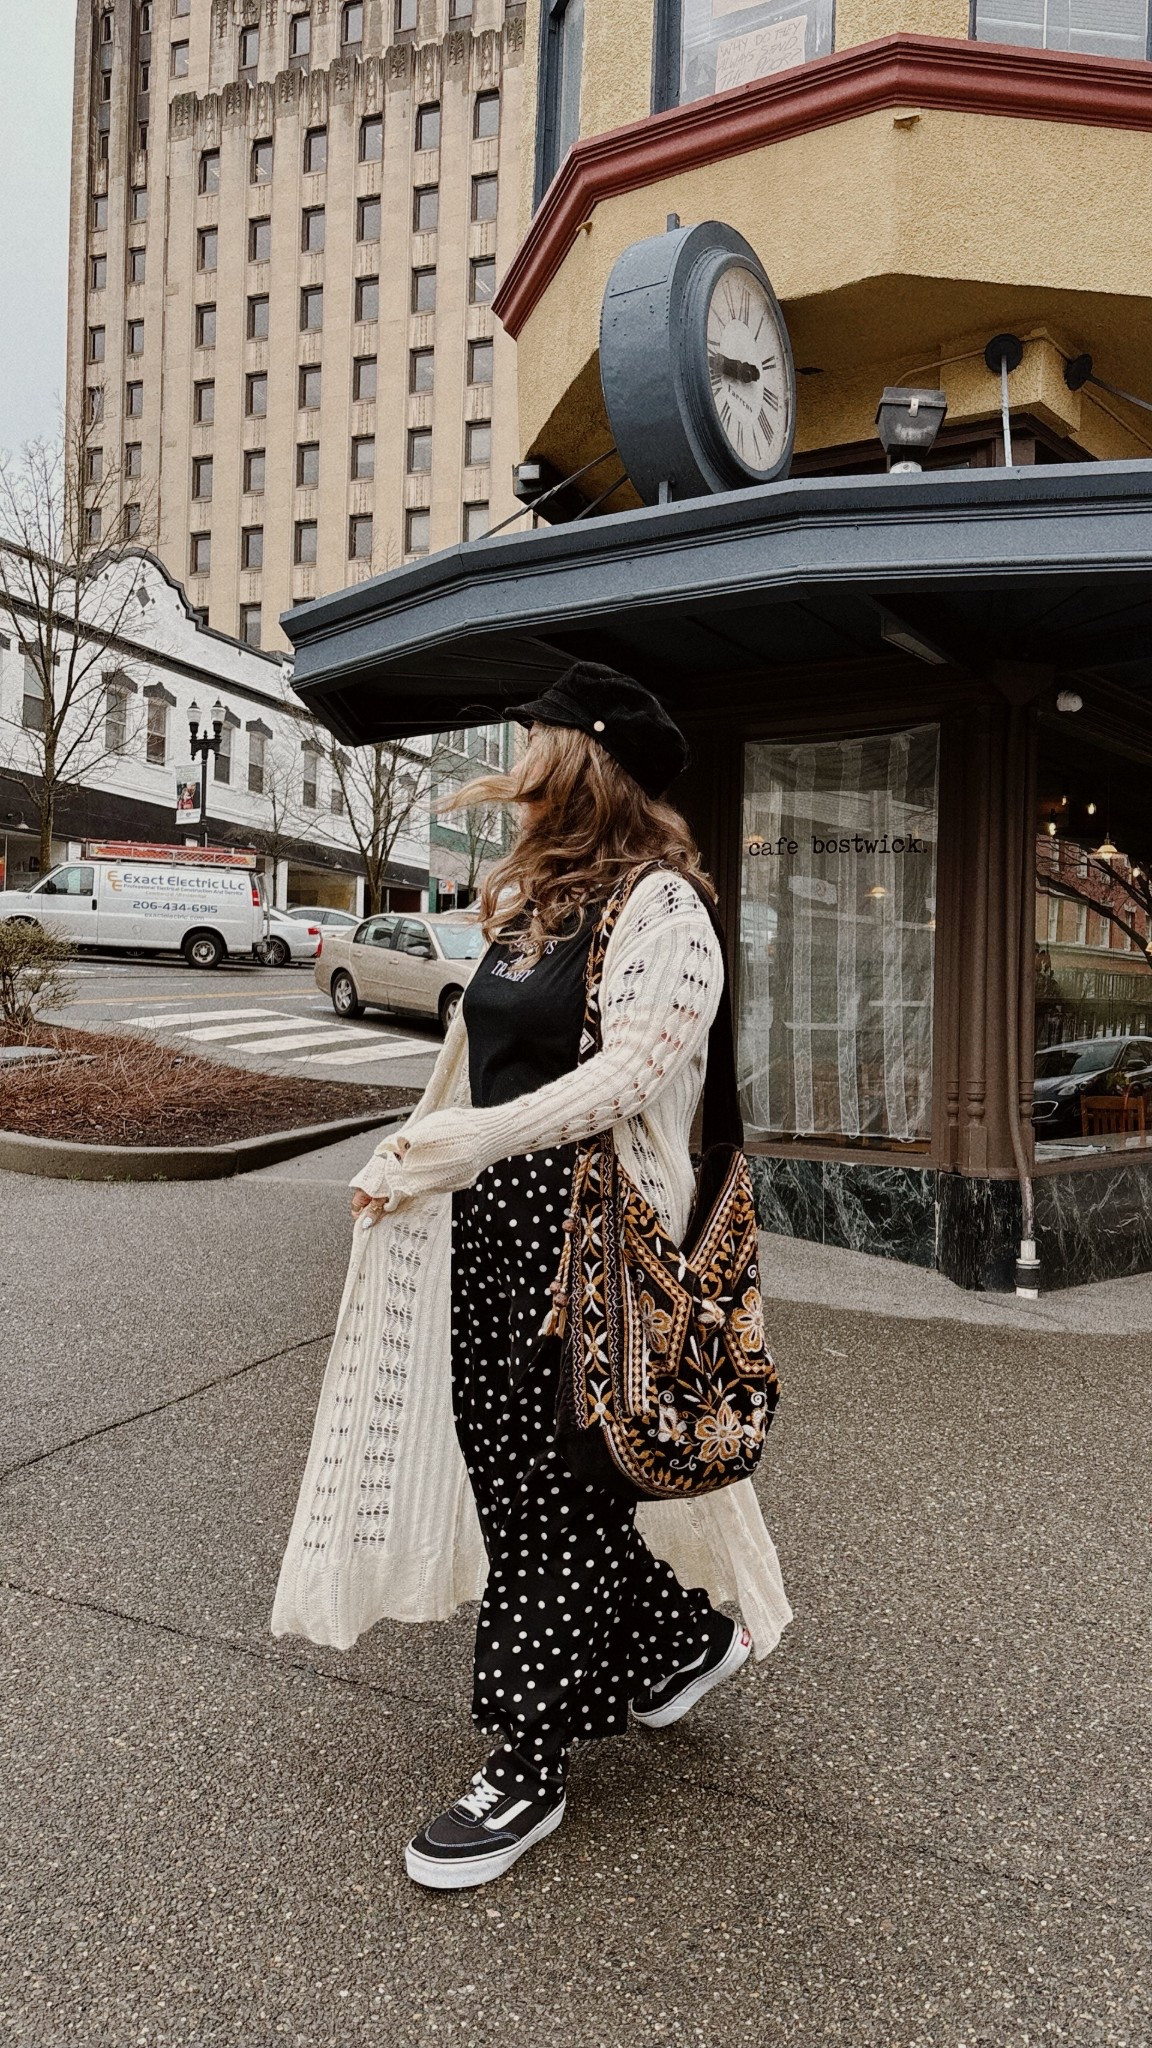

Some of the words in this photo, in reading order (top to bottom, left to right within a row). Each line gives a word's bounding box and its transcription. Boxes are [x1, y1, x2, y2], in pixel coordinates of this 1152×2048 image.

[720, 37, 748, 57] WHY
[755, 31, 771, 46] DO
[774, 20, 802, 40] THEY
[748, 837, 799, 857] cafe
[811, 833, 929, 855] bostwick.
[123, 873, 164, 886] Exact
[167, 876, 219, 890] Electric
[132, 900, 218, 914] 206-434-6915
